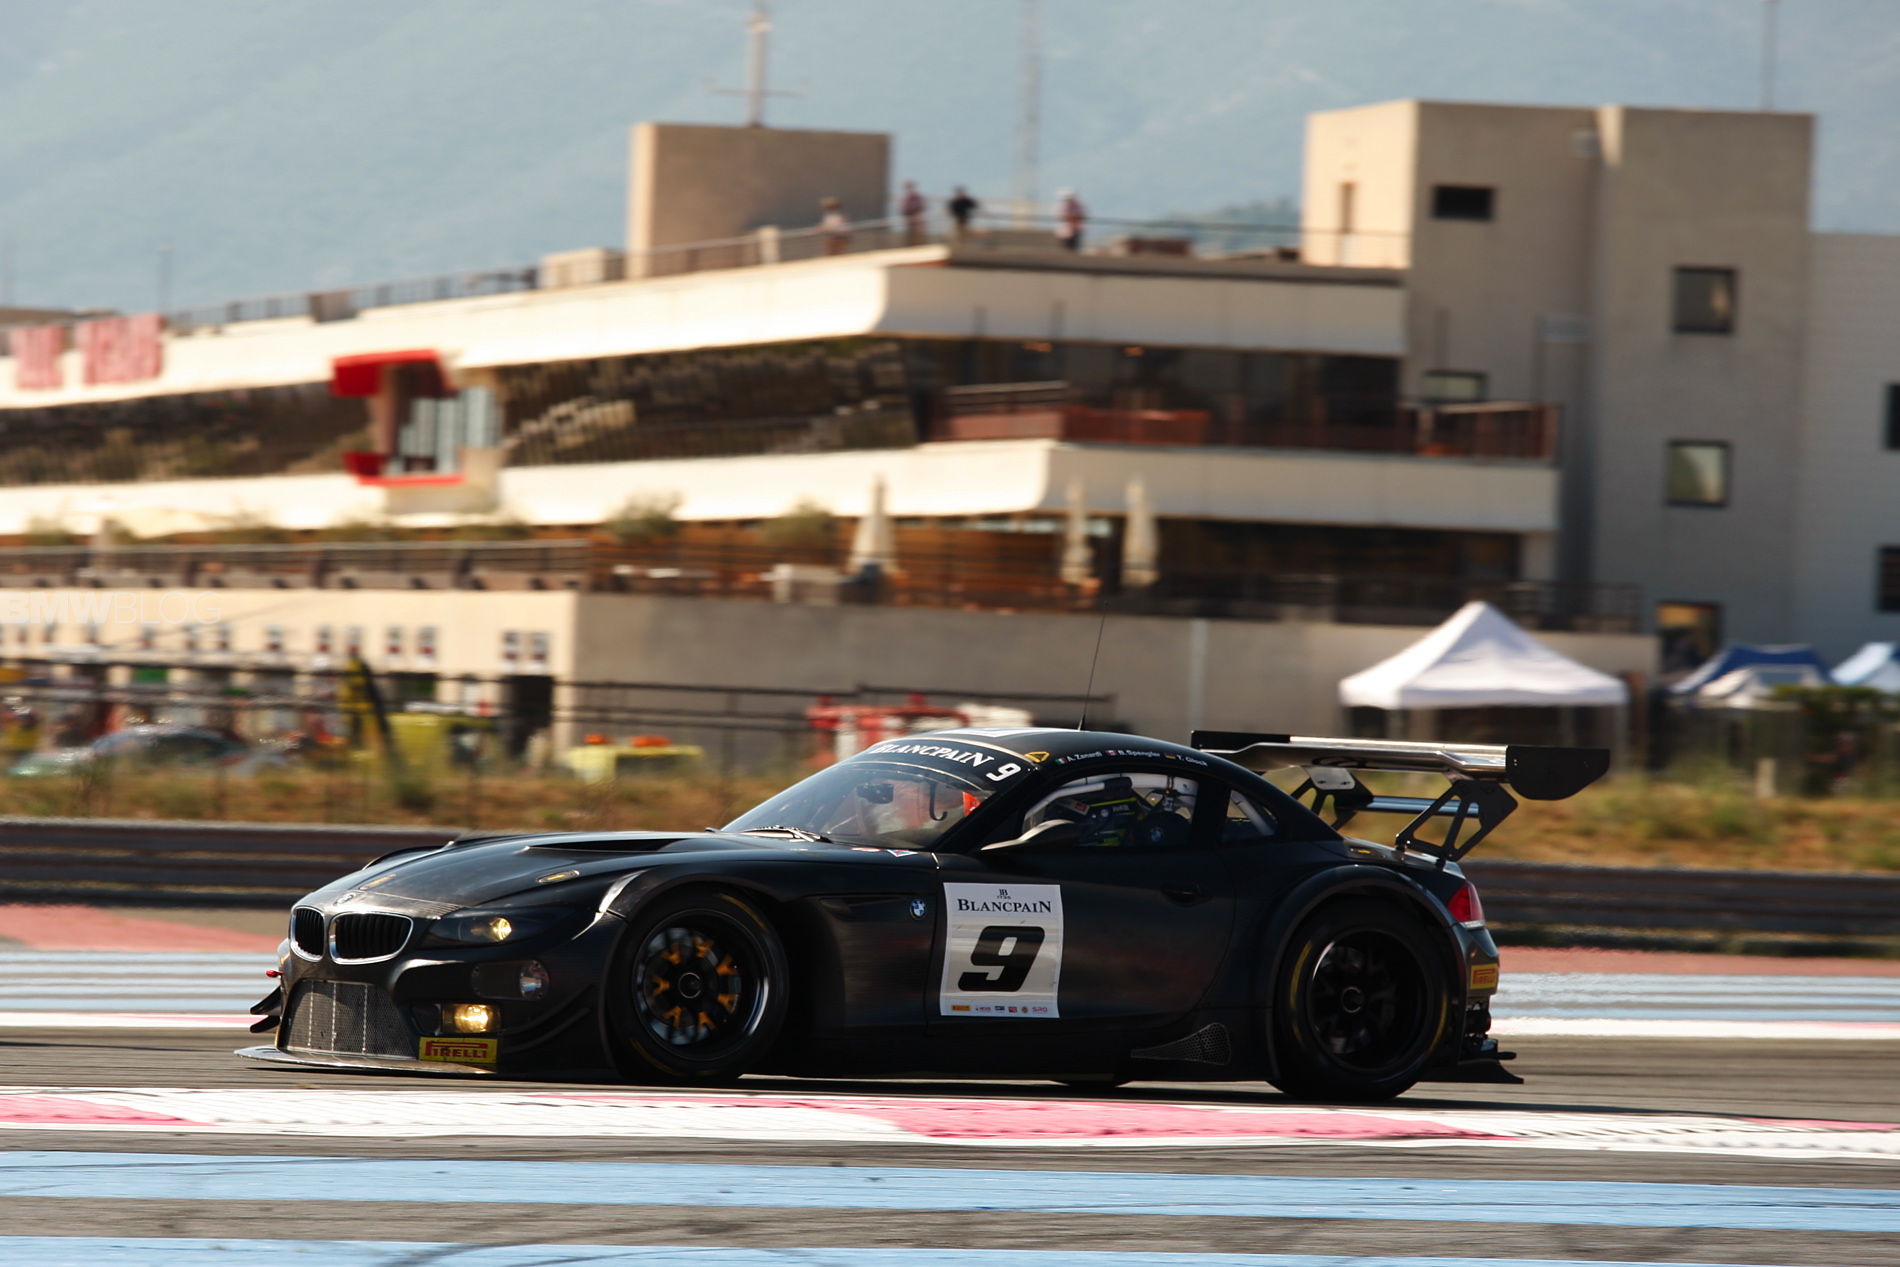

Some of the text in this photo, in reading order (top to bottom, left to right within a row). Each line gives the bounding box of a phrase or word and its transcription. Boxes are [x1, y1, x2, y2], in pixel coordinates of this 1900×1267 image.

[868, 744, 1022, 782] BLANCPAIN 9
[957, 898, 1051, 913] BLANCPAIN
[958, 926, 1045, 992] 9
[425, 1041, 489, 1059] PIRELLI
